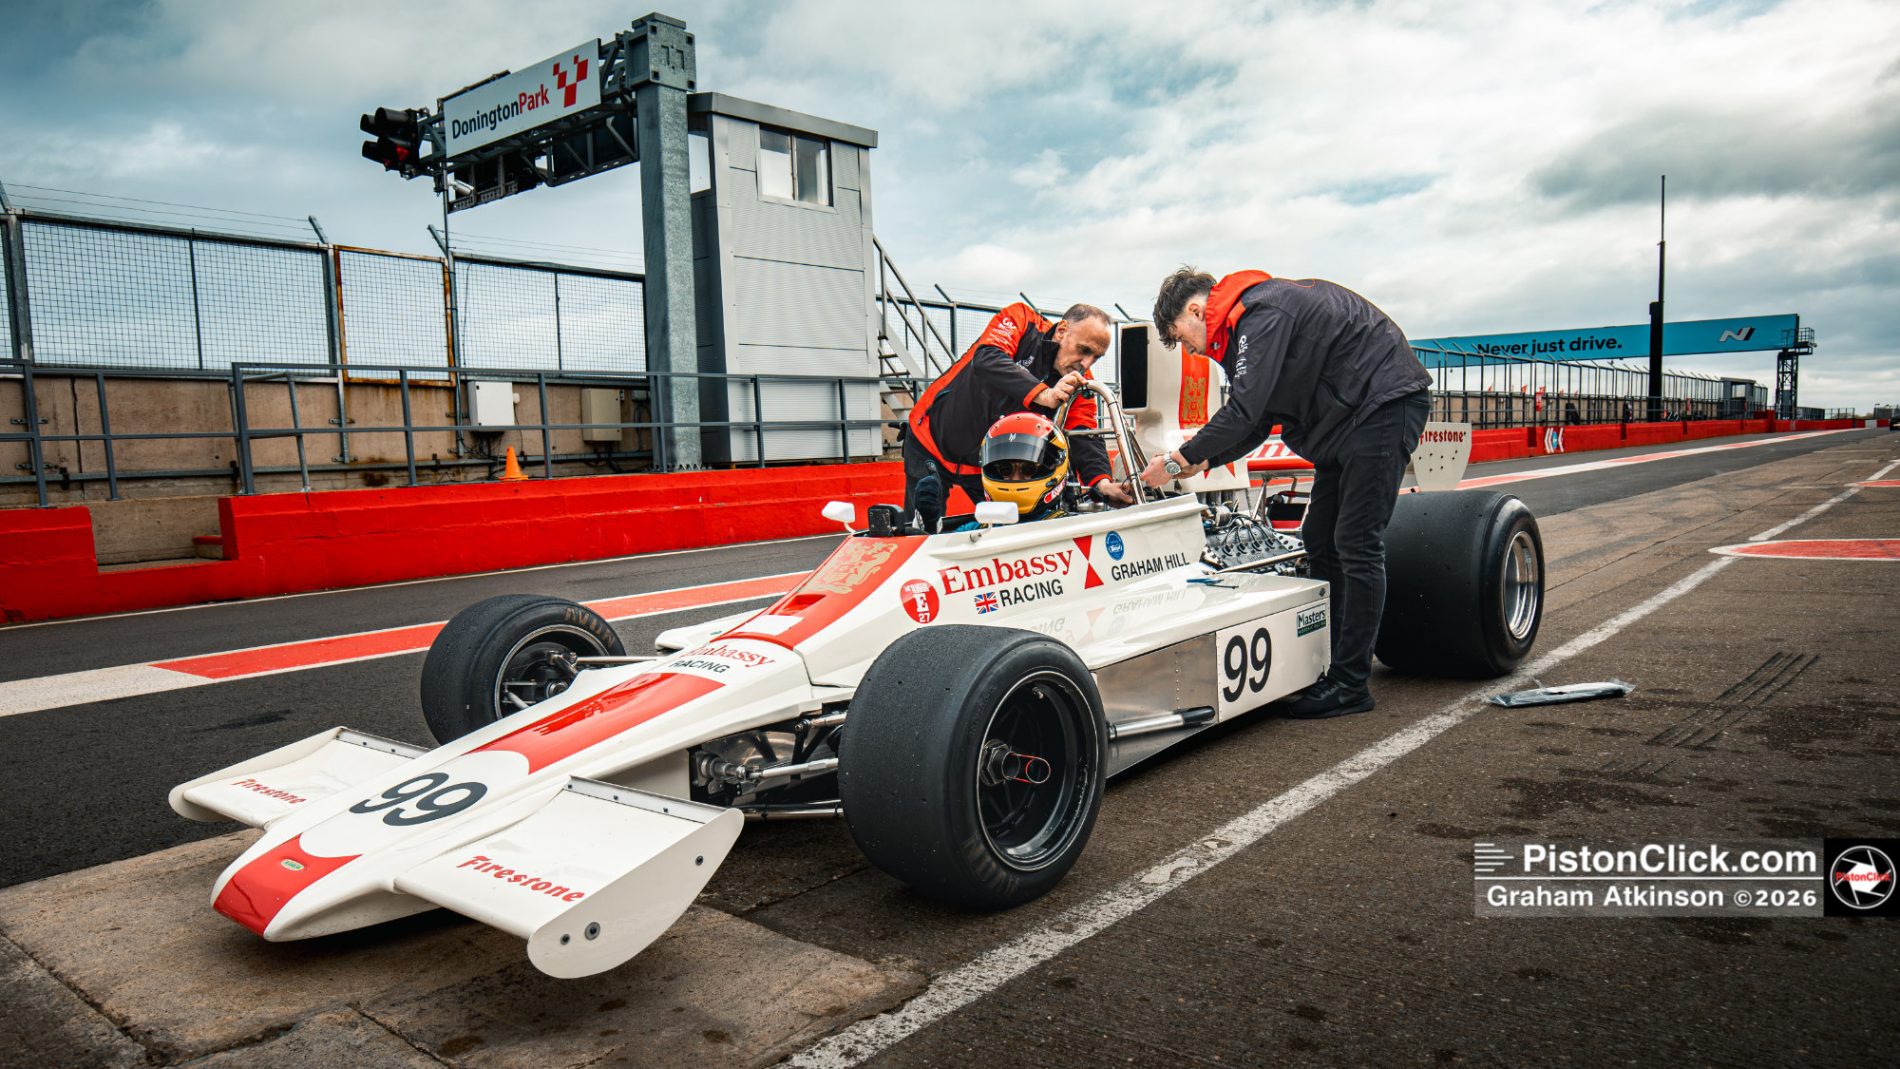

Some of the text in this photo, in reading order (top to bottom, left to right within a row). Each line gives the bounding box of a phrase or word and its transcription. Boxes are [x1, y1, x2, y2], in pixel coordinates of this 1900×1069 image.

[452, 84, 550, 139] DoningtonPark
[1477, 335, 1623, 356] Never just drive.
[937, 549, 1073, 595] Embassy
[1111, 552, 1190, 582] GRAHAM HILL
[1000, 579, 1064, 607] RACING
[1298, 609, 1326, 628] Masters
[669, 660, 730, 673] RACING
[1222, 627, 1272, 703] 99
[232, 778, 307, 805] Firestone
[349, 772, 488, 827] 99
[456, 855, 586, 902] Firestone
